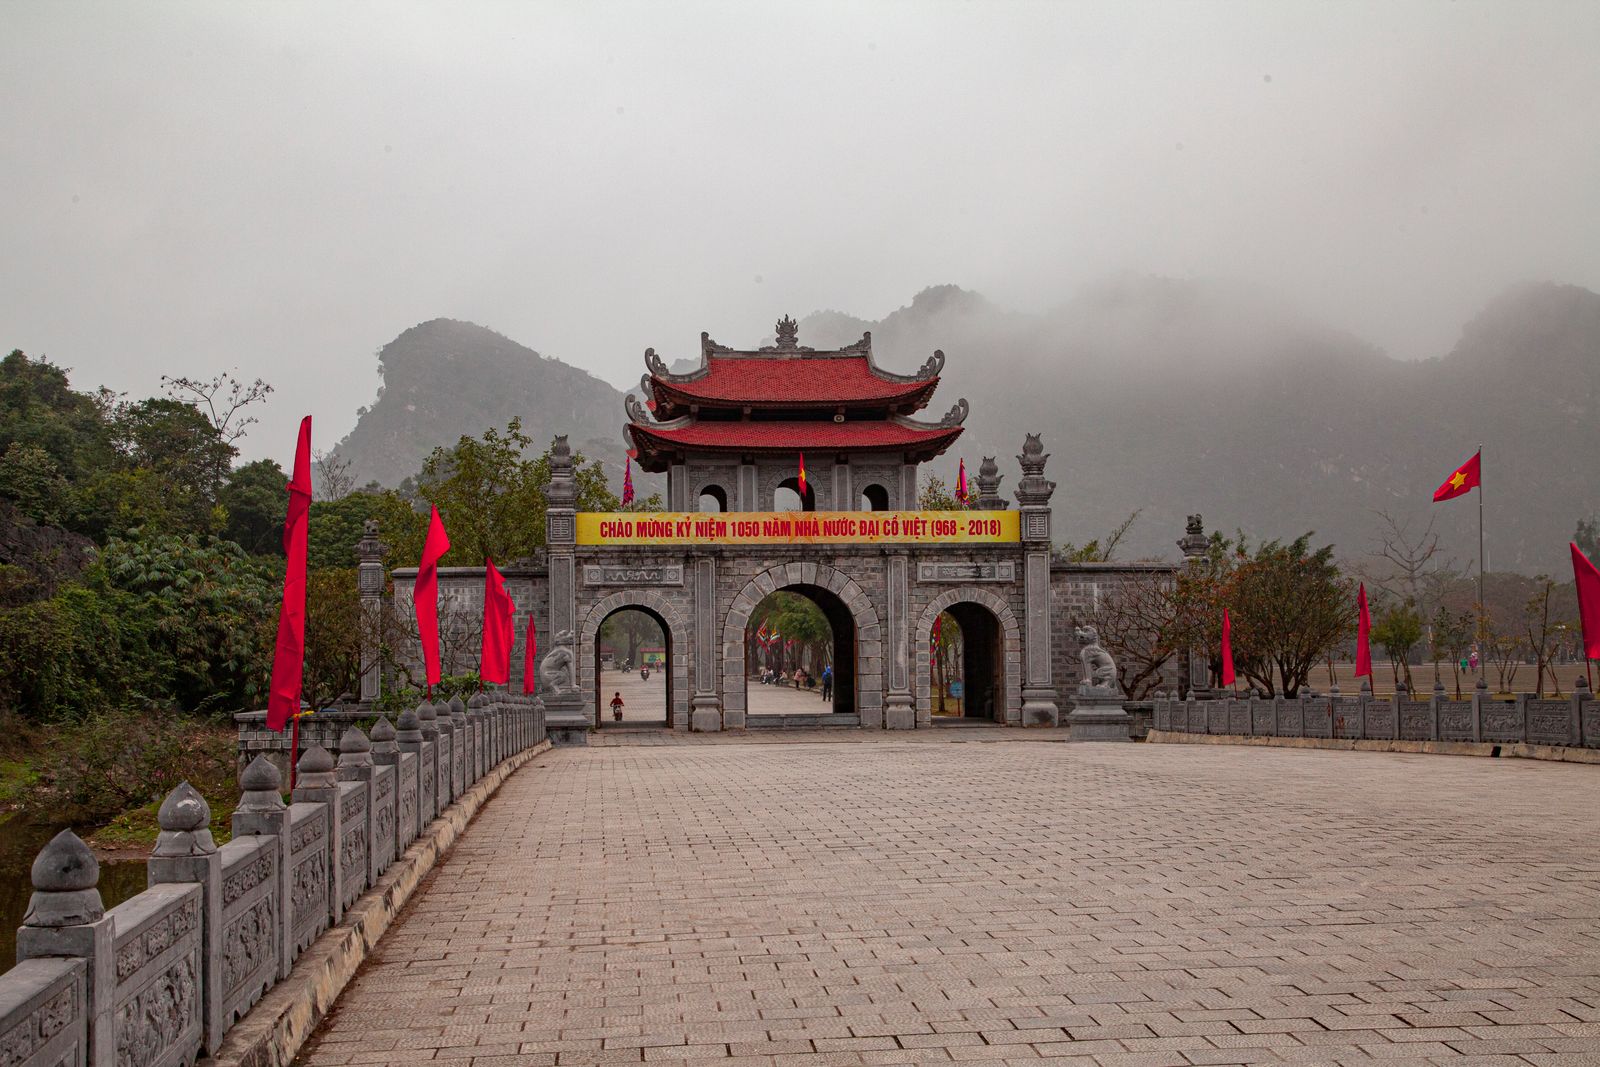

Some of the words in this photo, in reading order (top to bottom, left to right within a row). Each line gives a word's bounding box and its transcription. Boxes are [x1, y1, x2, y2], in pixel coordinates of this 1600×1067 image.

[600, 519, 633, 537] CHÀO
[637, 519, 673, 537] MỪNG
[676, 516, 692, 537] KỶ
[695, 518, 727, 540] NIỆM
[730, 522, 760, 537] 1050
[762, 518, 792, 536] NĂM
[794, 518, 821, 536] NHÀ
[823, 517, 856, 536] NƯỚC
[858, 520, 880, 539] ĐẠI
[902, 517, 928, 539] VIỆT
[930, 520, 957, 537] (968
[968, 520, 1001, 536] 2018)
